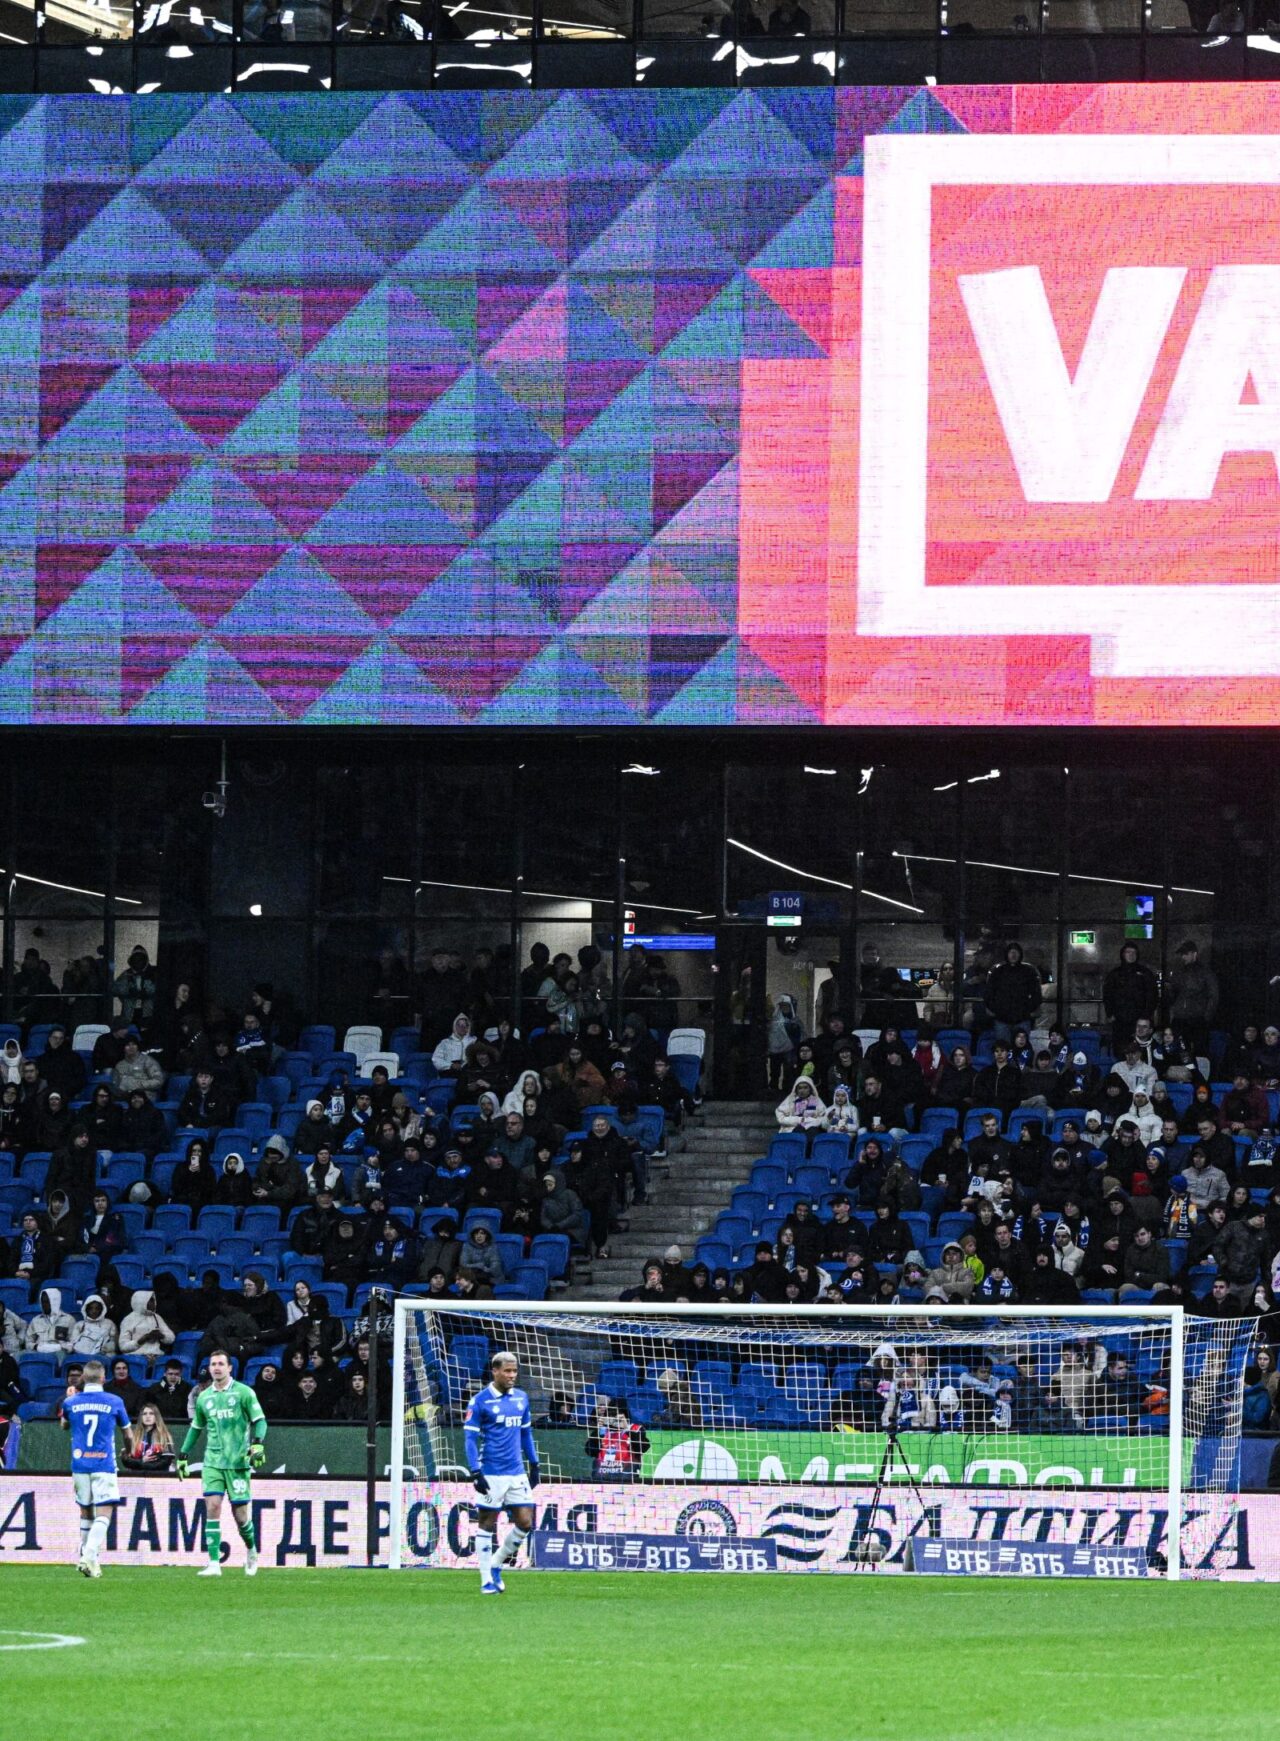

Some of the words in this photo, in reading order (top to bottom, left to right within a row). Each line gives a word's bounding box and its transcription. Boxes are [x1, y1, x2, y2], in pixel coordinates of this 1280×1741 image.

[782, 898, 800, 909] 104
[216, 1409, 234, 1420] ВТБ
[505, 1415, 523, 1428] ВТБ
[84, 1414, 98, 1447] 7
[232, 1479, 247, 1494] 99
[251, 1499, 349, 1566] ГДЕ
[568, 1544, 614, 1567] ВТБ
[646, 1546, 691, 1570] ВТБ
[723, 1549, 768, 1572] ВТБ
[946, 1550, 990, 1573] ВТБ
[1020, 1552, 1065, 1575] ВТБ
[1094, 1556, 1138, 1577] ВТБ
